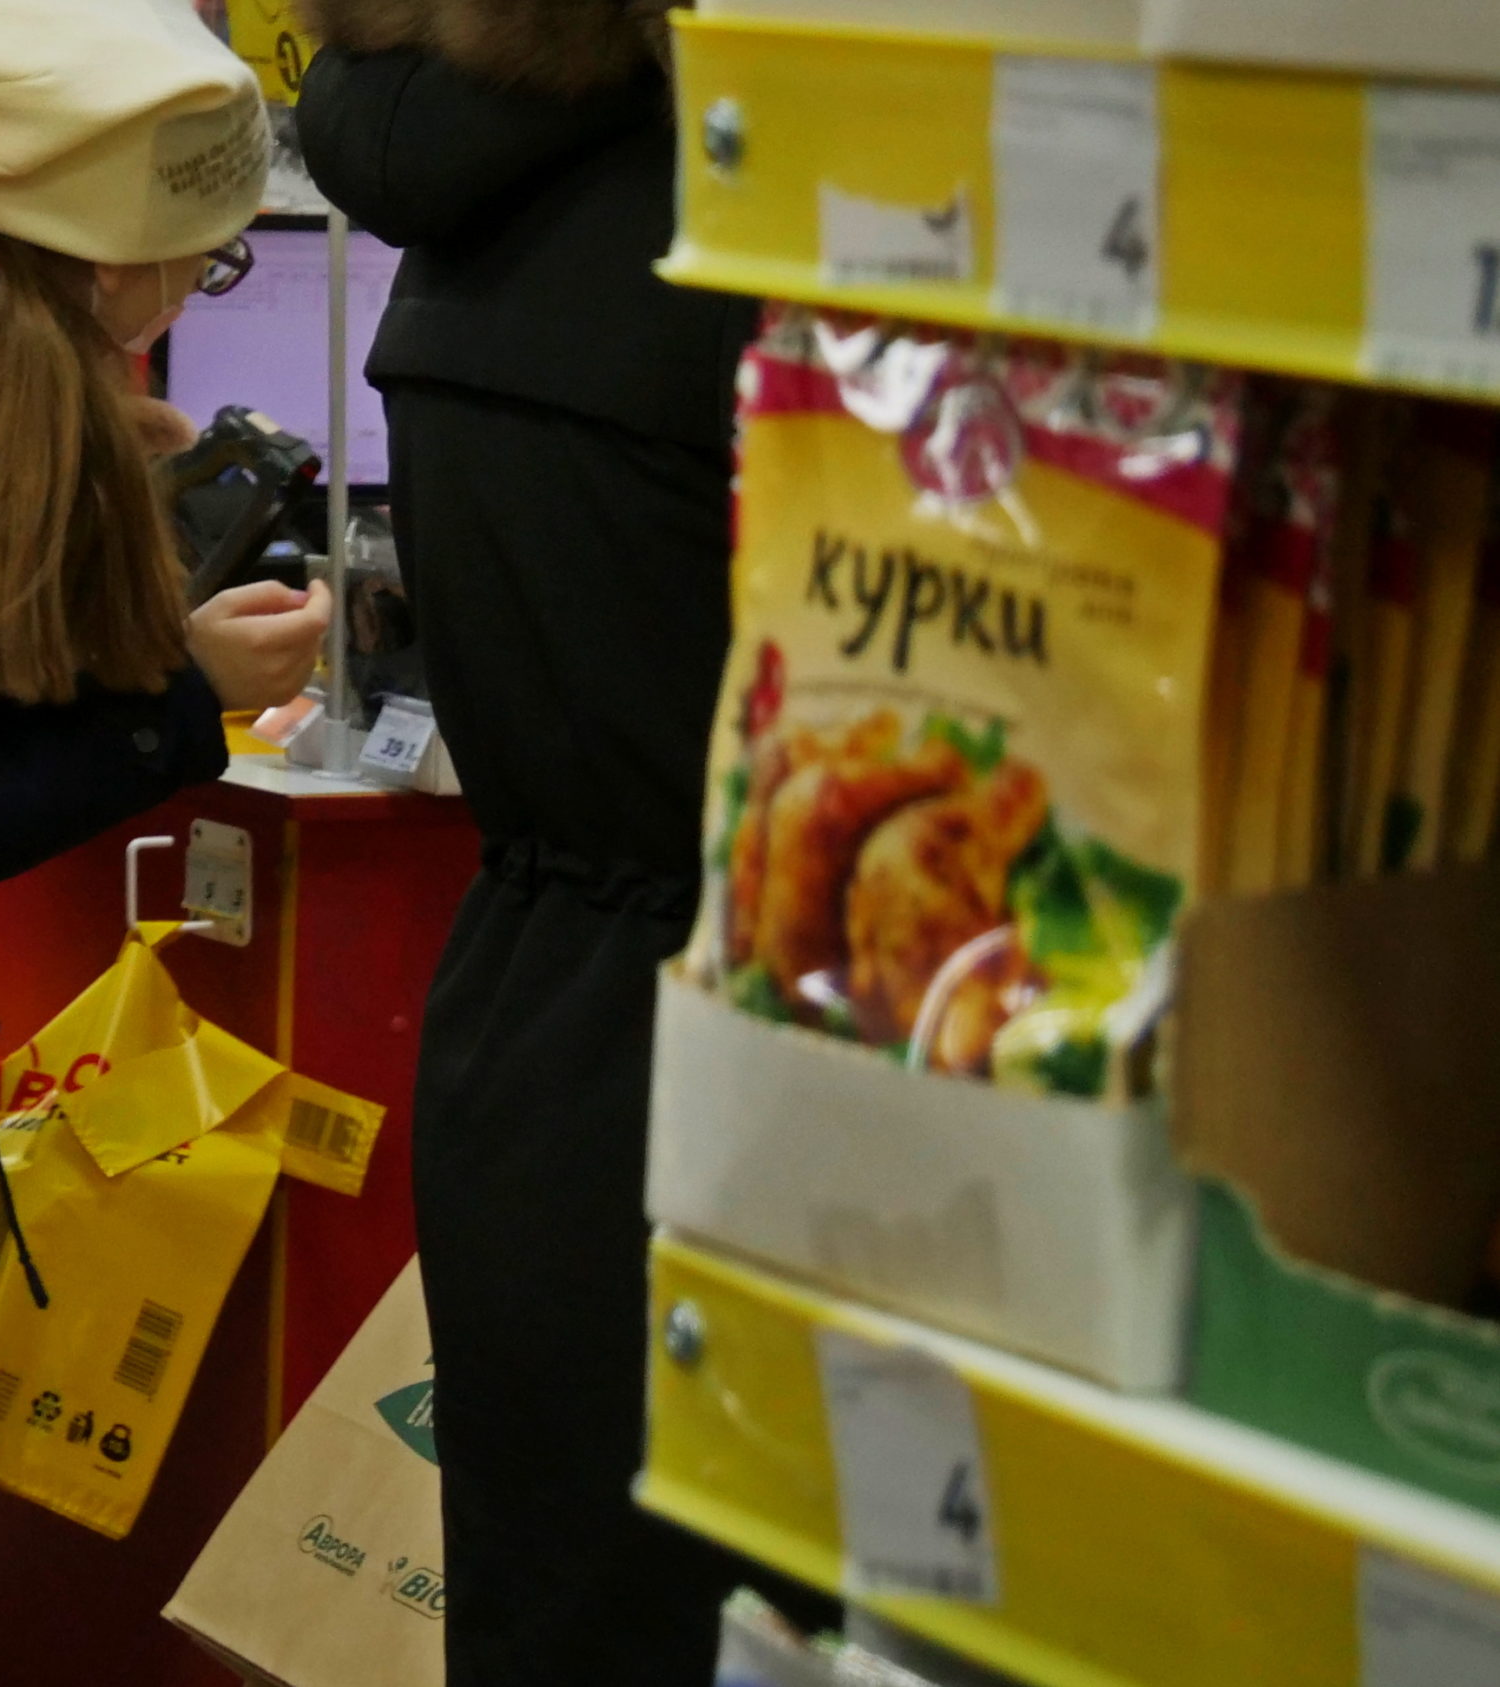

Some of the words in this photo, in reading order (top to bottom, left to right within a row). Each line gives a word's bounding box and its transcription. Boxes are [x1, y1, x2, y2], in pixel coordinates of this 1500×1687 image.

[1102, 196, 1150, 279] 4
[807, 526, 1049, 674] курки
[937, 1459, 983, 1546] 4
